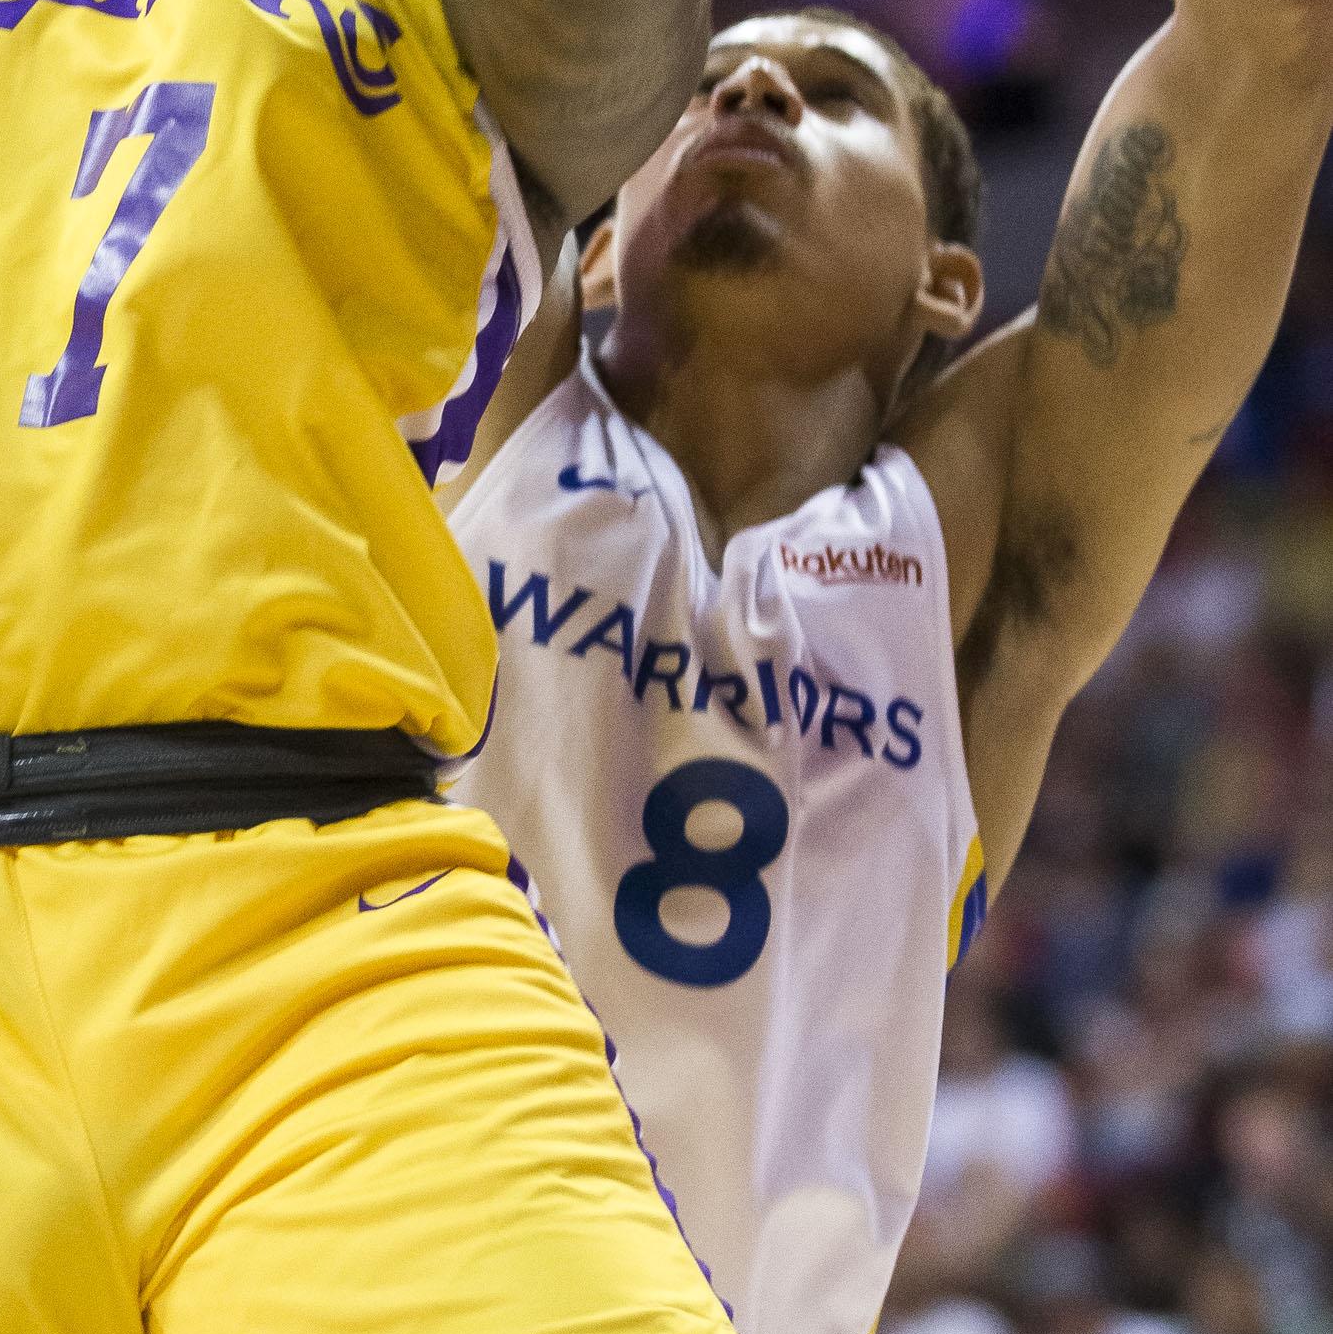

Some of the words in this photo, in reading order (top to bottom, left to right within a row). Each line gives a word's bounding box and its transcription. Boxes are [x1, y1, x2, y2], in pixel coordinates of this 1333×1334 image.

[18, 82, 217, 427] 7
[487, 558, 924, 769] WARRIORS
[613, 757, 789, 989] 8
